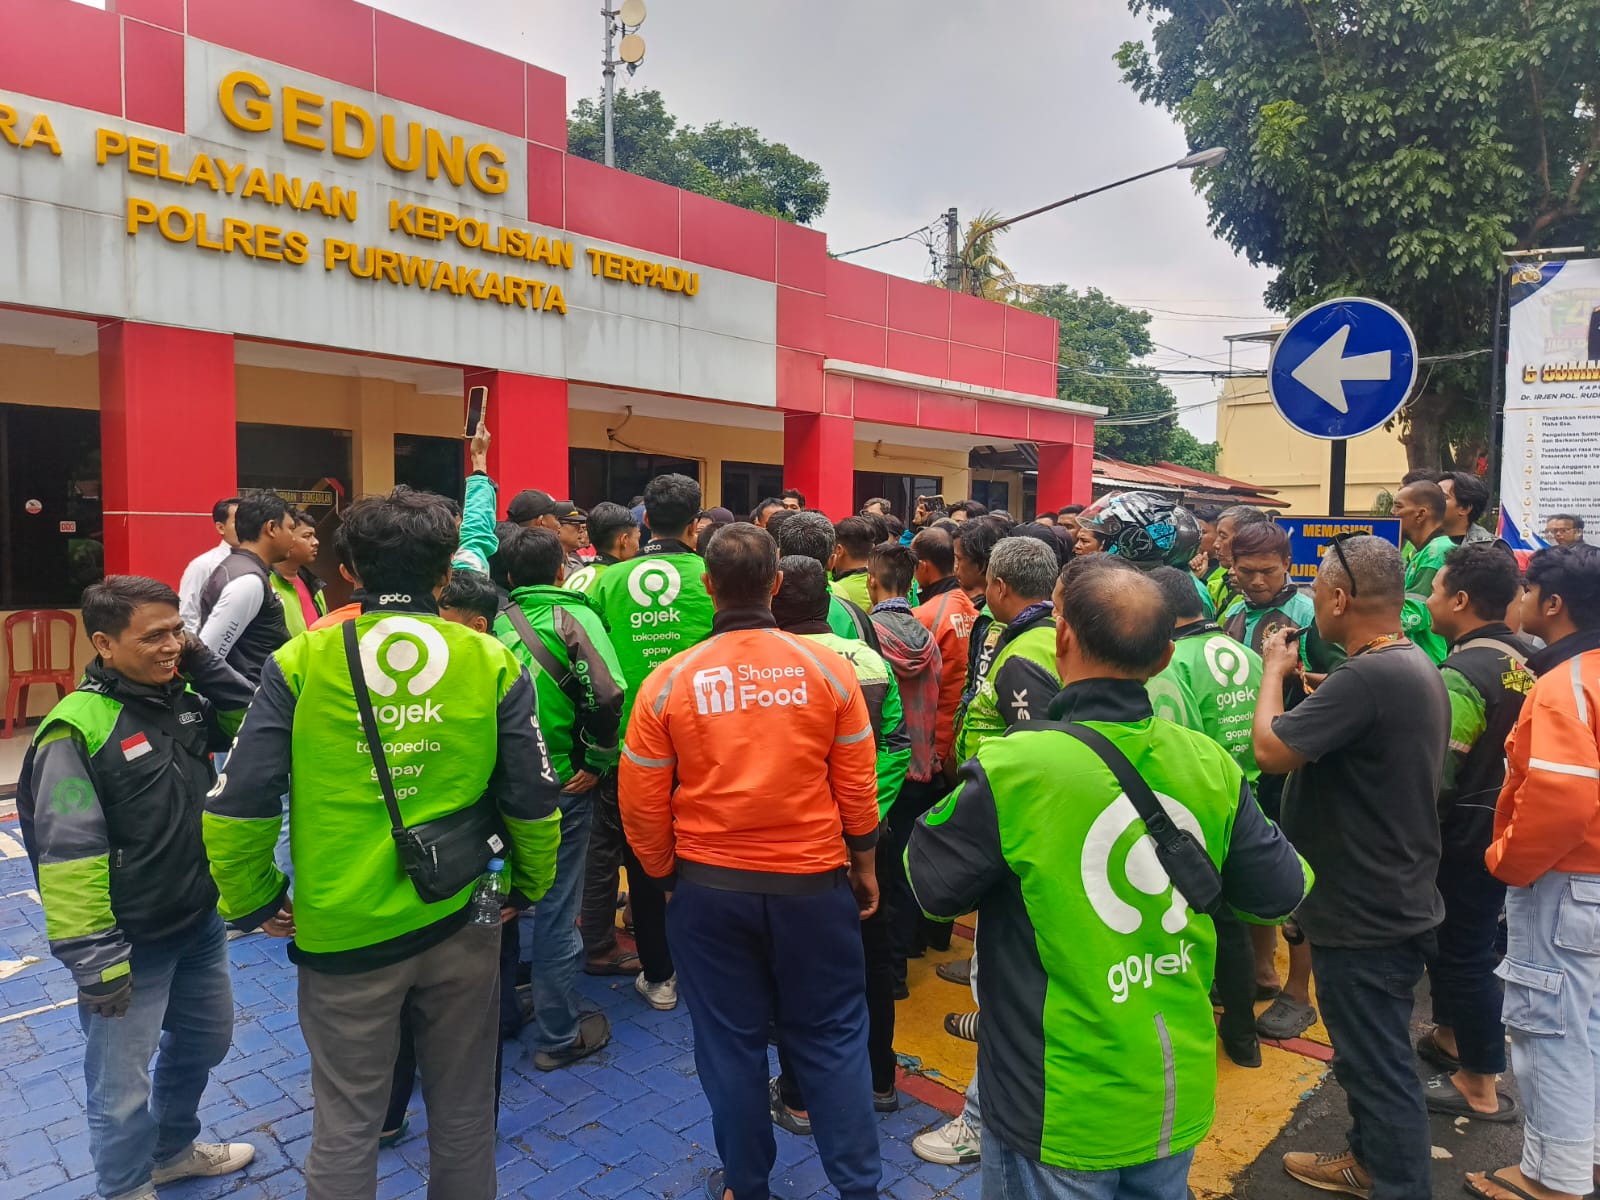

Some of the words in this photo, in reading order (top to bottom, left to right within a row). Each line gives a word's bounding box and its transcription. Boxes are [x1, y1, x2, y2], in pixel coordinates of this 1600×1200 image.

[218, 70, 509, 195] GEDUNG
[96, 127, 357, 222] PELAYANAN
[388, 199, 573, 270] KEPOLISIAN
[585, 248, 700, 297] TERPADU
[127, 197, 310, 265] POLRES
[324, 238, 568, 315] PURWAKARTA
[379, 592, 412, 605] goto
[630, 607, 681, 628] gojek
[632, 631, 681, 642] tokopedia
[642, 646, 672, 657] gopay
[737, 664, 805, 683] Shopee
[739, 681, 808, 710] Food
[1216, 685, 1256, 711] gojek
[1225, 728, 1252, 741] gopay
[356, 739, 440, 756] toopedia
[370, 764, 424, 781] gpay
[1107, 939, 1196, 1004] gojek
